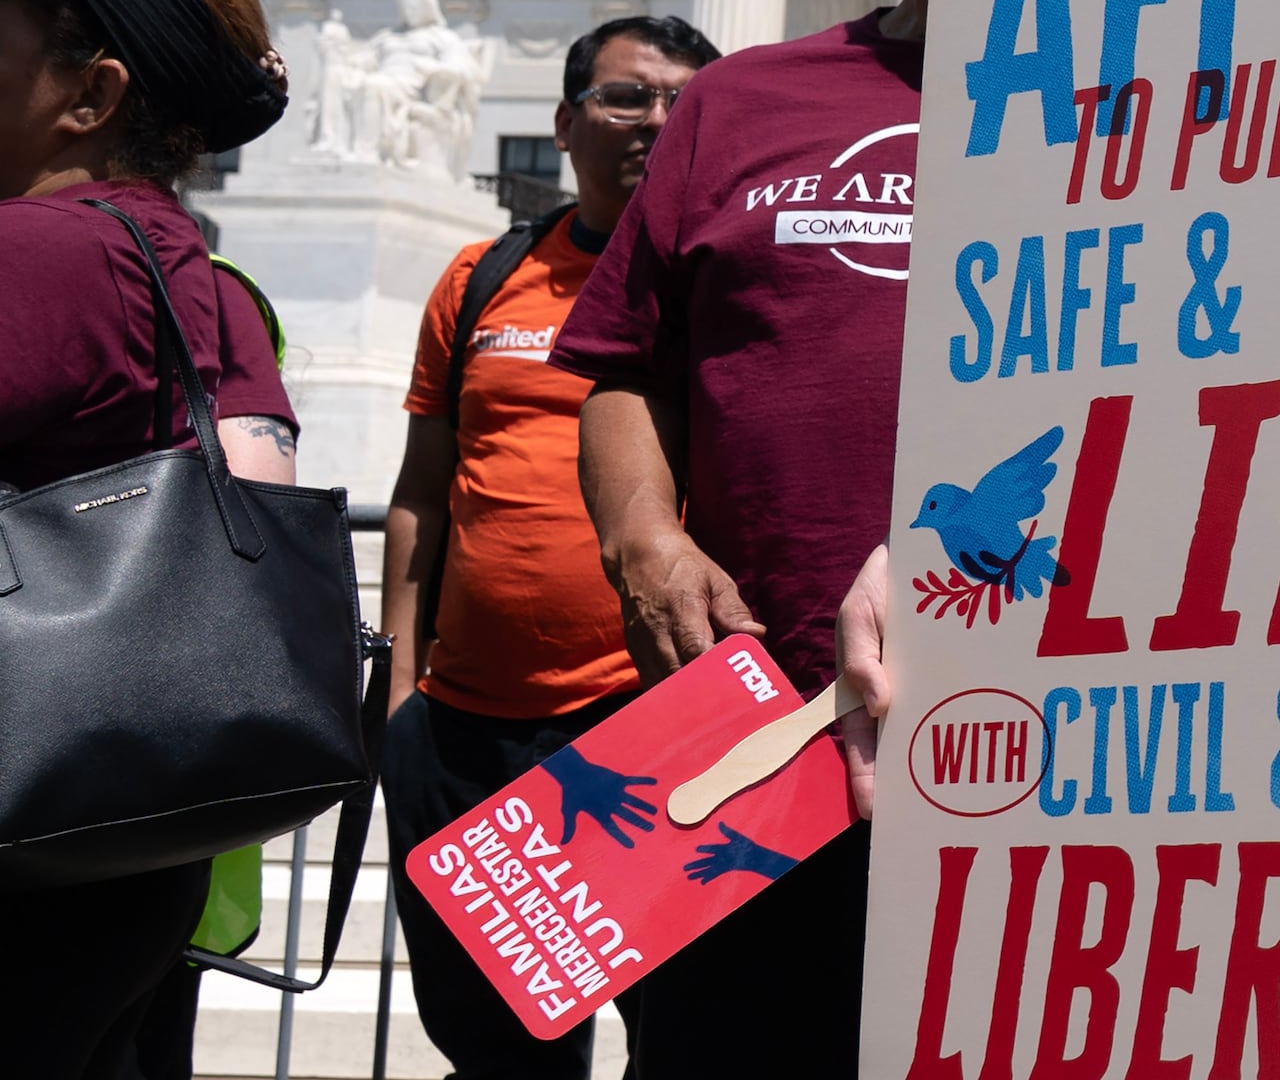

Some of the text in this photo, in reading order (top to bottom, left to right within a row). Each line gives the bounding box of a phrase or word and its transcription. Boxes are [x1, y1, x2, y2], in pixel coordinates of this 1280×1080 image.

[745, 172, 914, 212] WE AR
[1066, 77, 1154, 205] TO
[792, 219, 912, 236] COMMUNIT
[472, 324, 556, 351] United
[949, 222, 1144, 384] SAFE
[1177, 211, 1243, 359] &
[726, 650, 780, 703] ACLU
[931, 719, 1028, 788] WITH
[1037, 681, 1237, 818] CIVIL
[429, 843, 577, 1022] FAMILIAS
[462, 818, 610, 999] MERECEN ESTAR
[495, 797, 643, 969] JUNTAS
